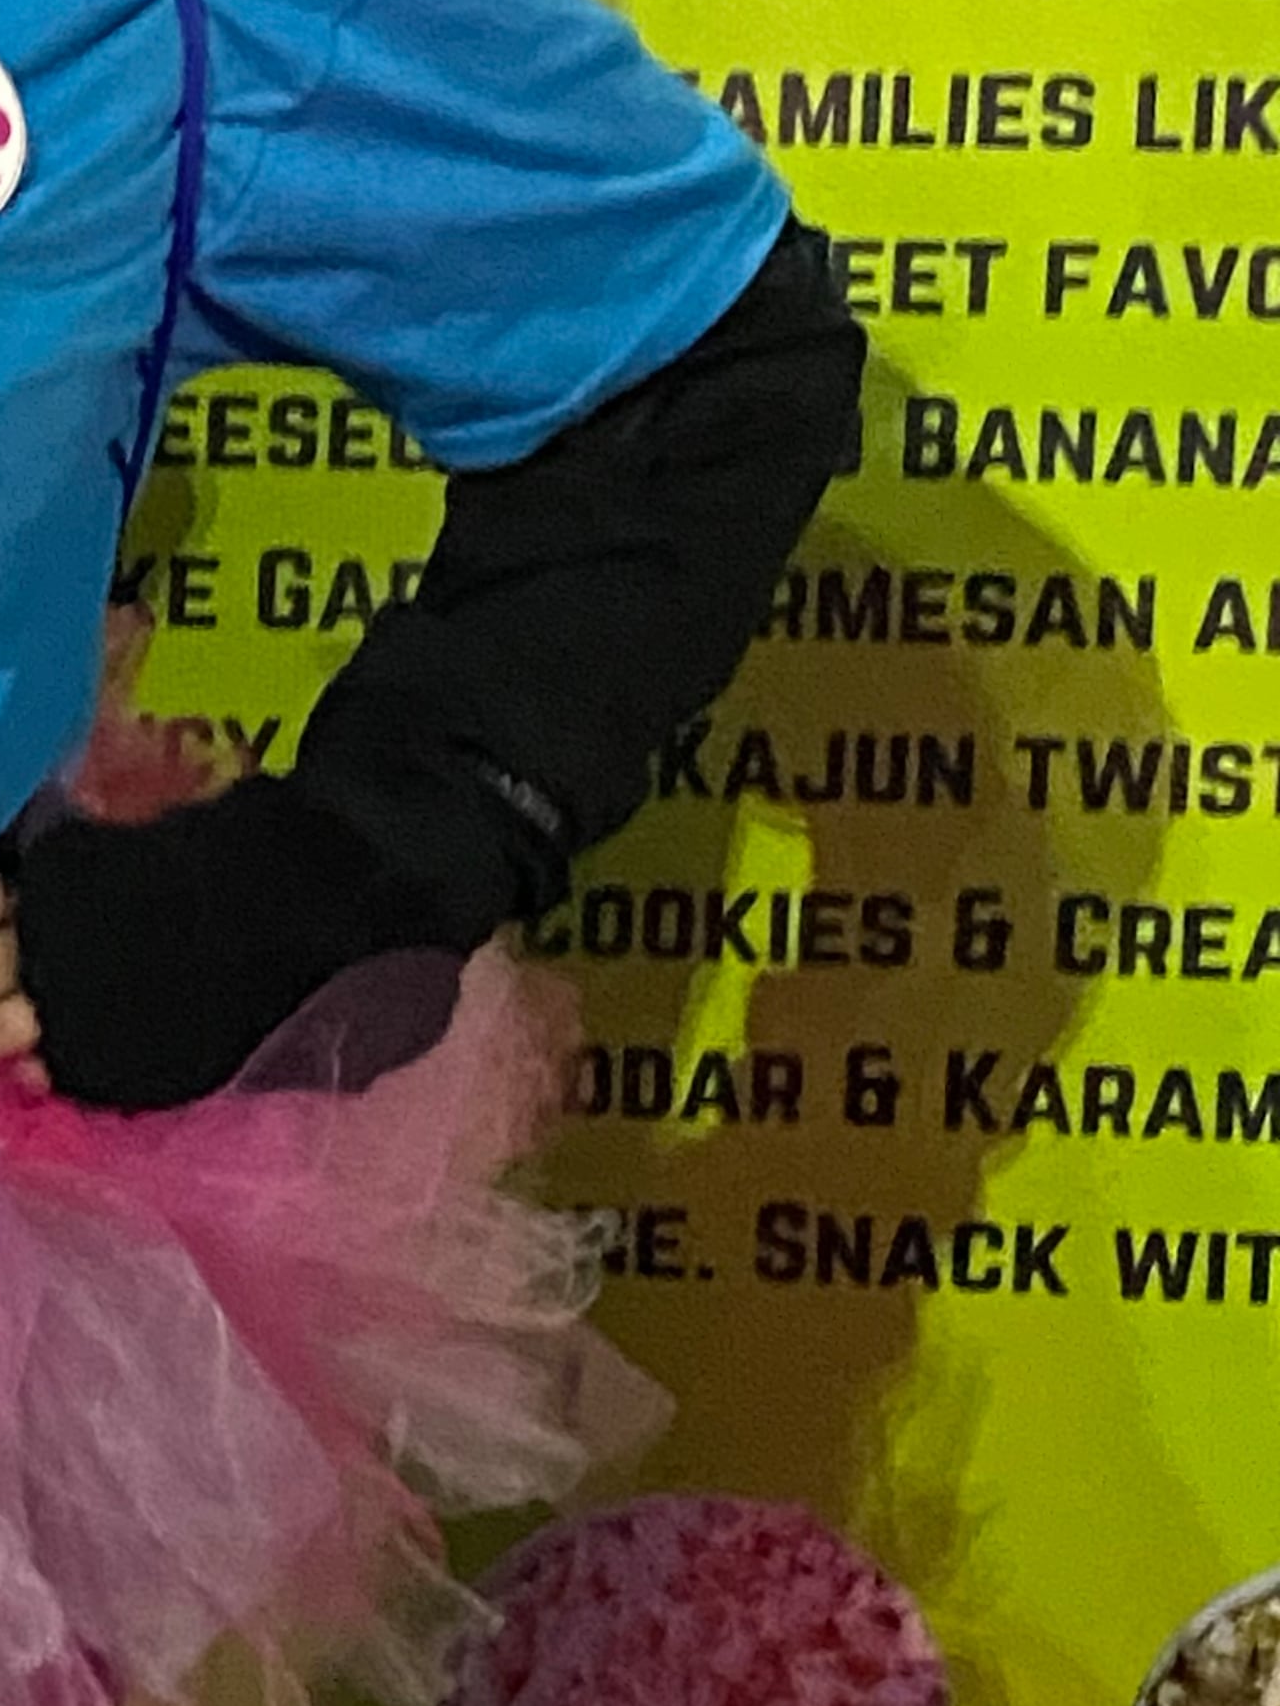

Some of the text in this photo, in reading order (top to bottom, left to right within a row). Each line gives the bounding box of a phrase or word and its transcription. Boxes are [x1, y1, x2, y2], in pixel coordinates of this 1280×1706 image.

[678, 70, 1095, 150] AMILIES
[953, 886, 1013, 973] &
[844, 1040, 901, 1127] &
[754, 1200, 1071, 1297] SNACK
